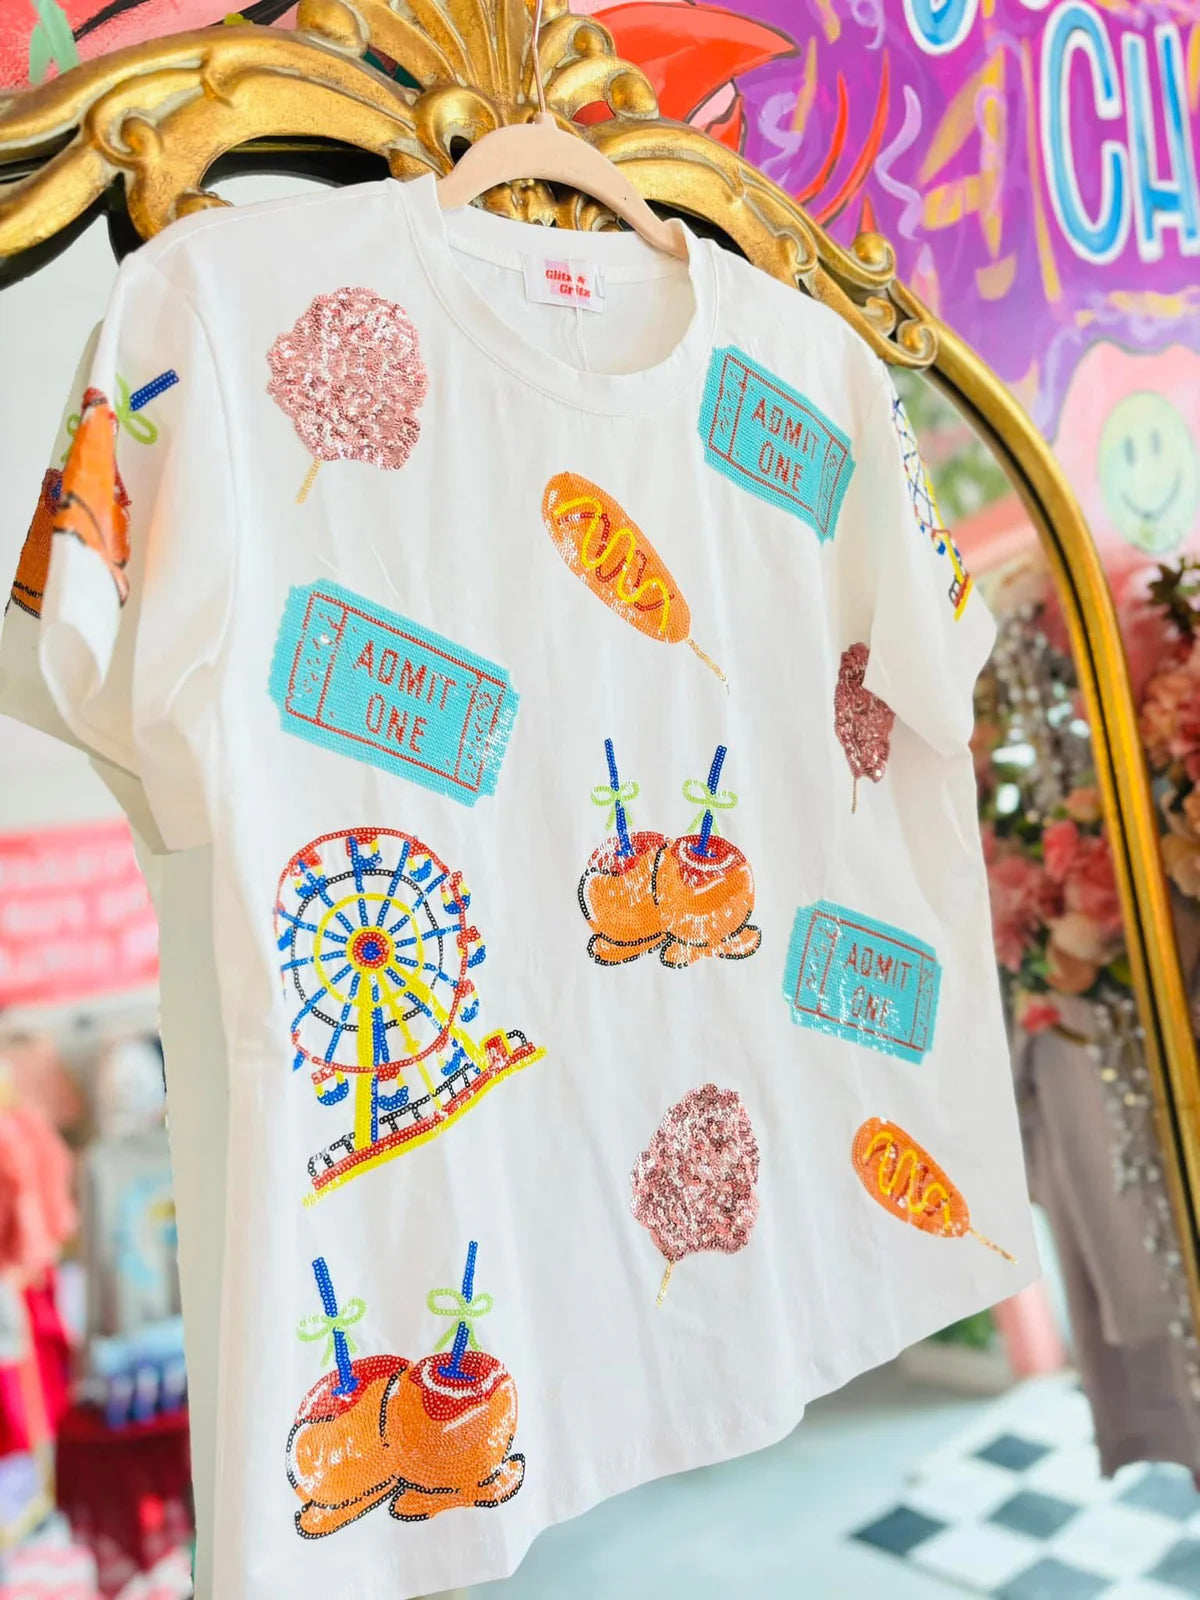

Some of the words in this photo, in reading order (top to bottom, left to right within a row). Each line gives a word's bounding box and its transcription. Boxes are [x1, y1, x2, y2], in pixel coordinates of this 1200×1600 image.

[751, 397, 819, 459] ADMIT
[758, 440, 804, 492] ONE
[353, 640, 457, 710] ADMIT
[365, 692, 428, 753] ONE
[843, 942, 912, 991] ADMIT
[851, 985, 893, 1028] ONE
